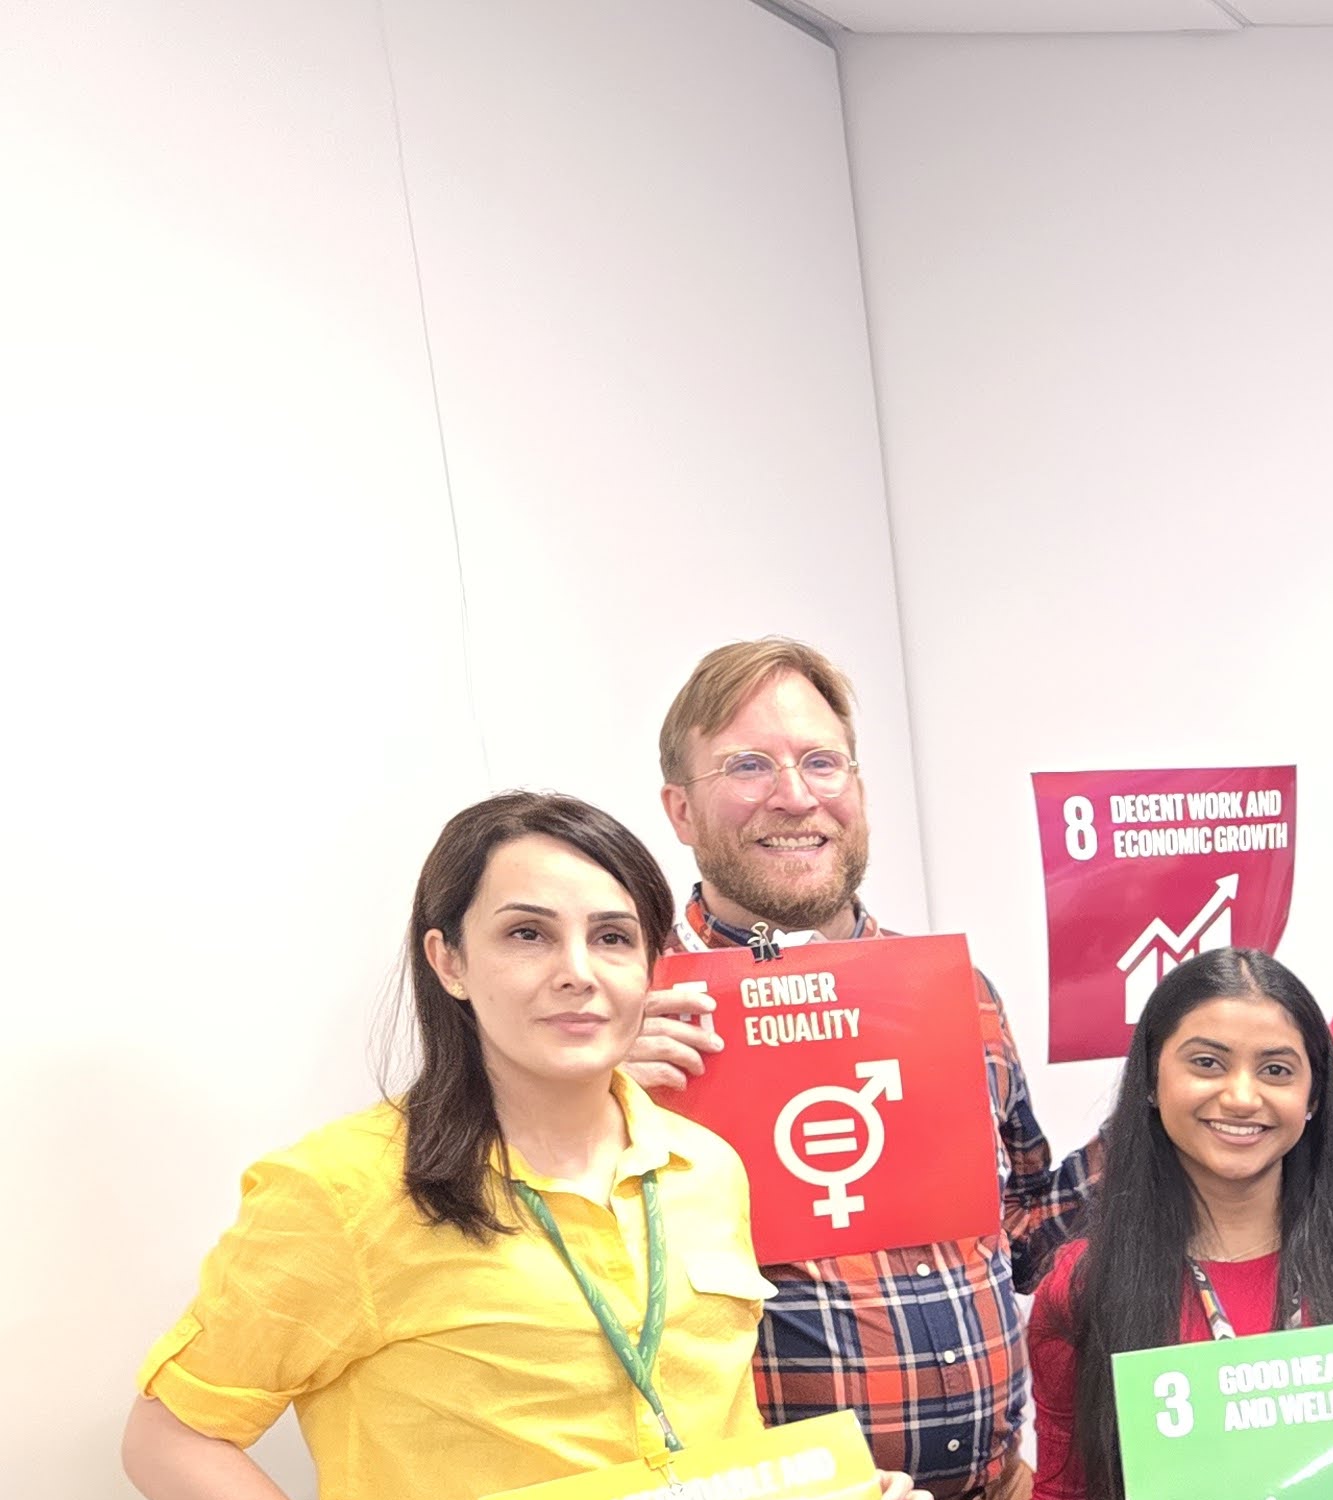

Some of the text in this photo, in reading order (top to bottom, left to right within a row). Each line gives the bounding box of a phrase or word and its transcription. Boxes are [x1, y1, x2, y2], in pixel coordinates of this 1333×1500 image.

[1110, 790, 1281, 823] DECENT WORK AND
[1063, 796, 1097, 861] 8
[1114, 823, 1288, 858] ECONOMIC GROWTH
[740, 972, 838, 1008] GENDER
[745, 1008, 860, 1047] EQUALITY
[1218, 1359, 1290, 1395] GOOD
[1153, 1370, 1194, 1438] 3
[1225, 1396, 1277, 1431] AND
